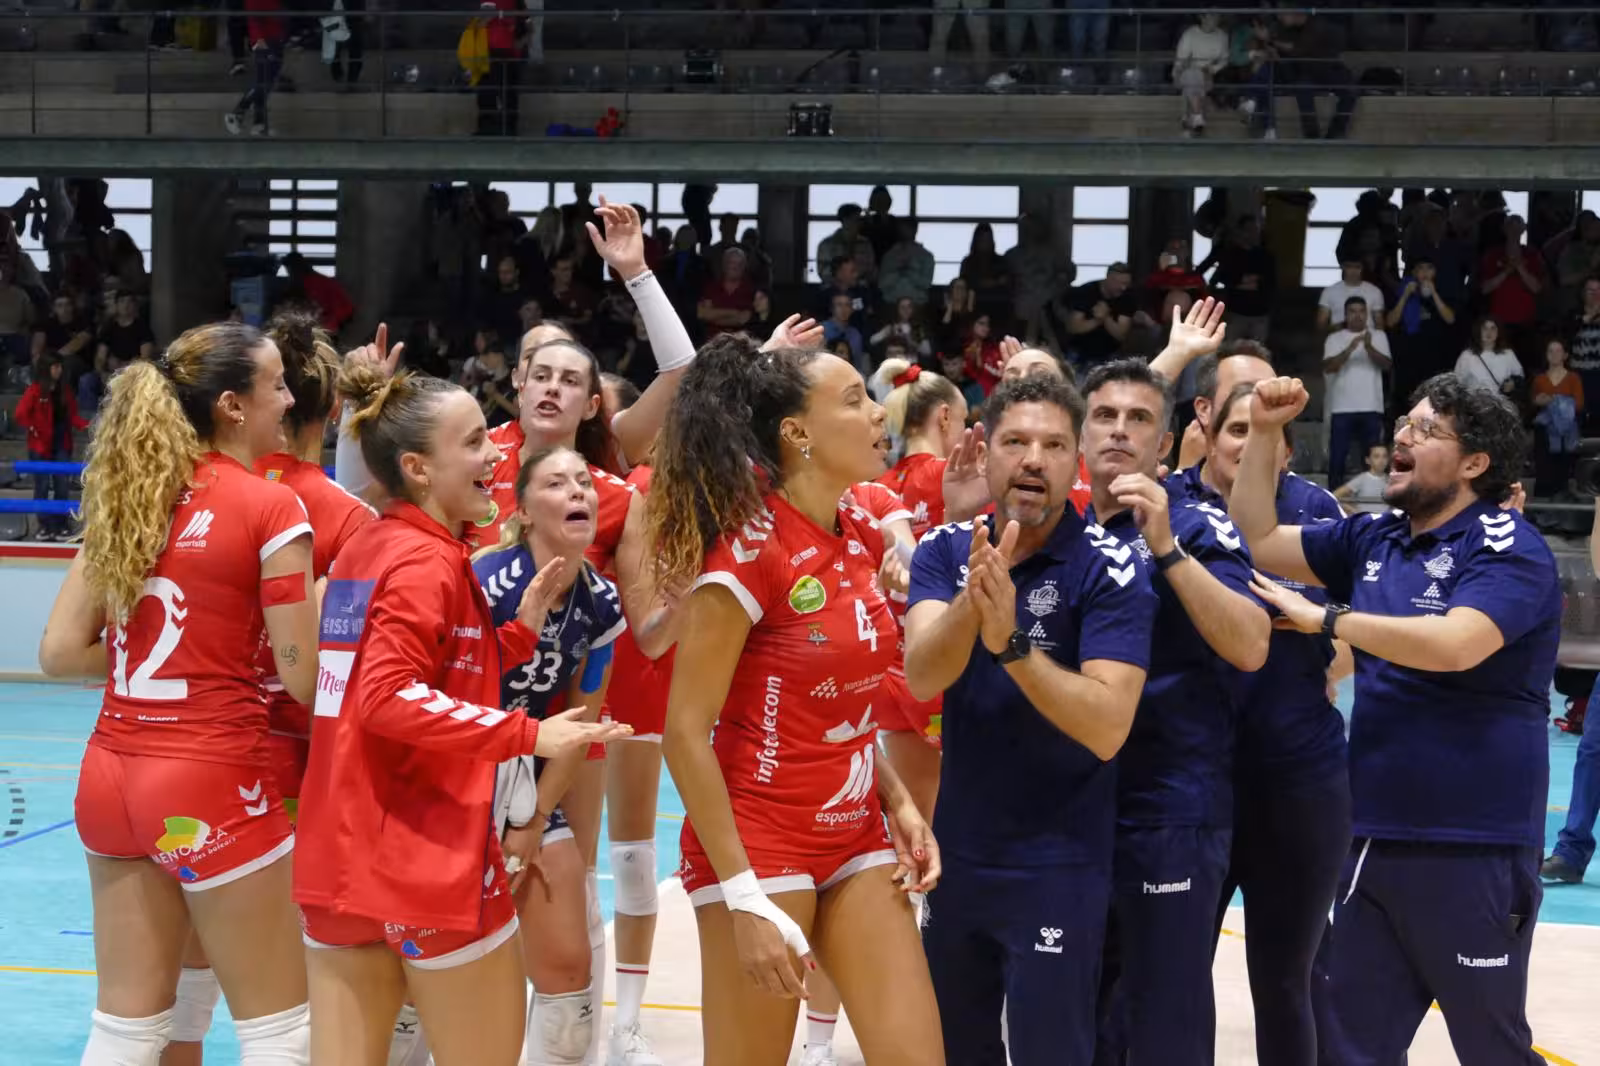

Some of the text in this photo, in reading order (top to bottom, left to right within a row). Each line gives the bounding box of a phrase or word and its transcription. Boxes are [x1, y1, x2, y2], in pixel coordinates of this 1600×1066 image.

[113, 576, 188, 700] 12
[855, 598, 879, 652] 4
[508, 649, 563, 692] 33
[753, 675, 782, 784] infotelecom
[1143, 877, 1191, 894] hummel
[1034, 943, 1063, 954] hummel
[1457, 953, 1509, 968] hummel
